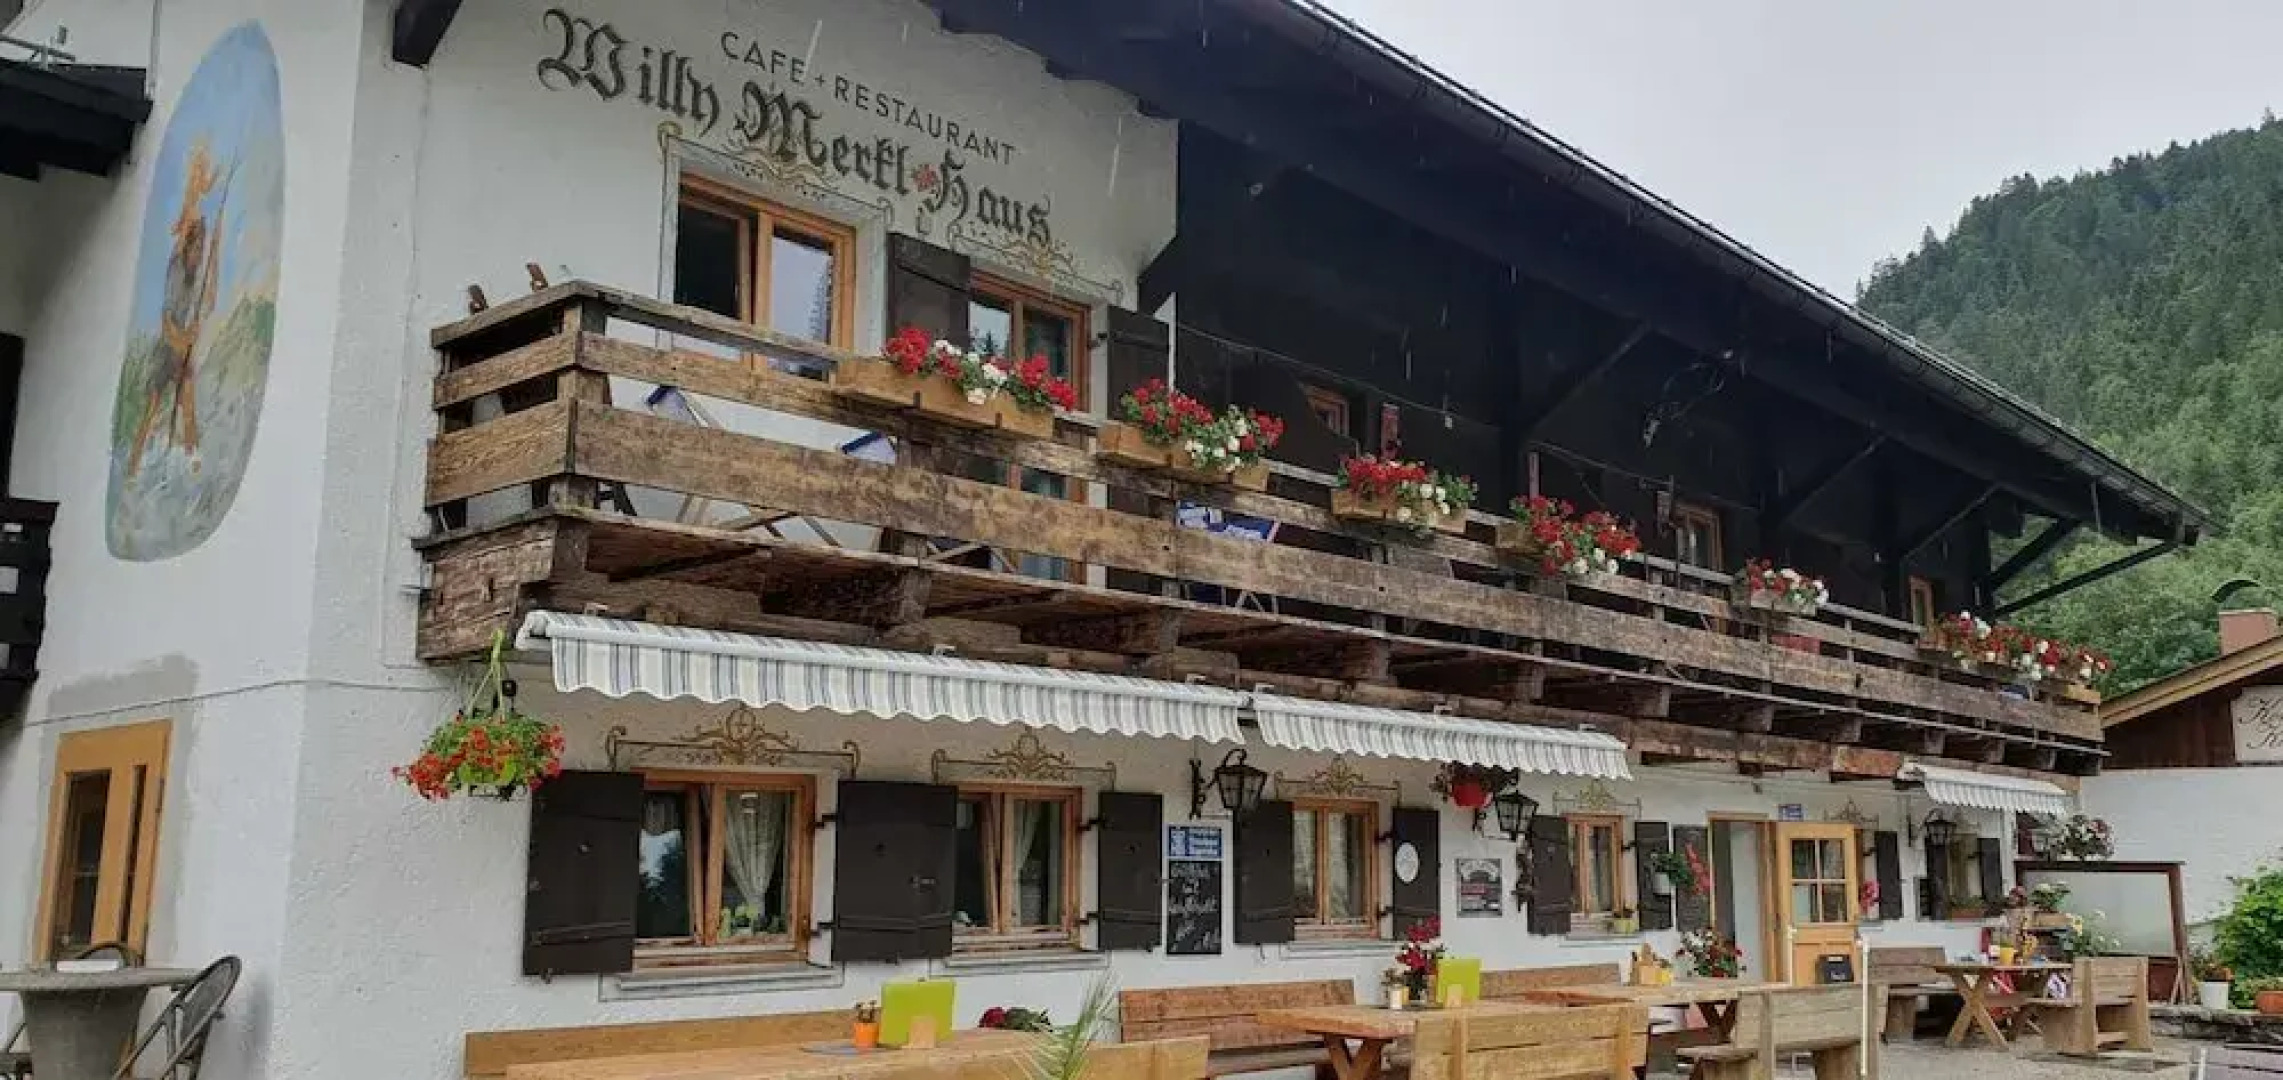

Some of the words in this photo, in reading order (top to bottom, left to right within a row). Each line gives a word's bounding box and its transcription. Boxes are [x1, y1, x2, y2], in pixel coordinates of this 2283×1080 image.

[536, 8, 720, 138] Willy
[733, 80, 911, 196] Merkl
[921, 148, 1052, 247] Haus
[721, 31, 805, 84] CAFE
[833, 75, 1016, 165] RESTAURANT
